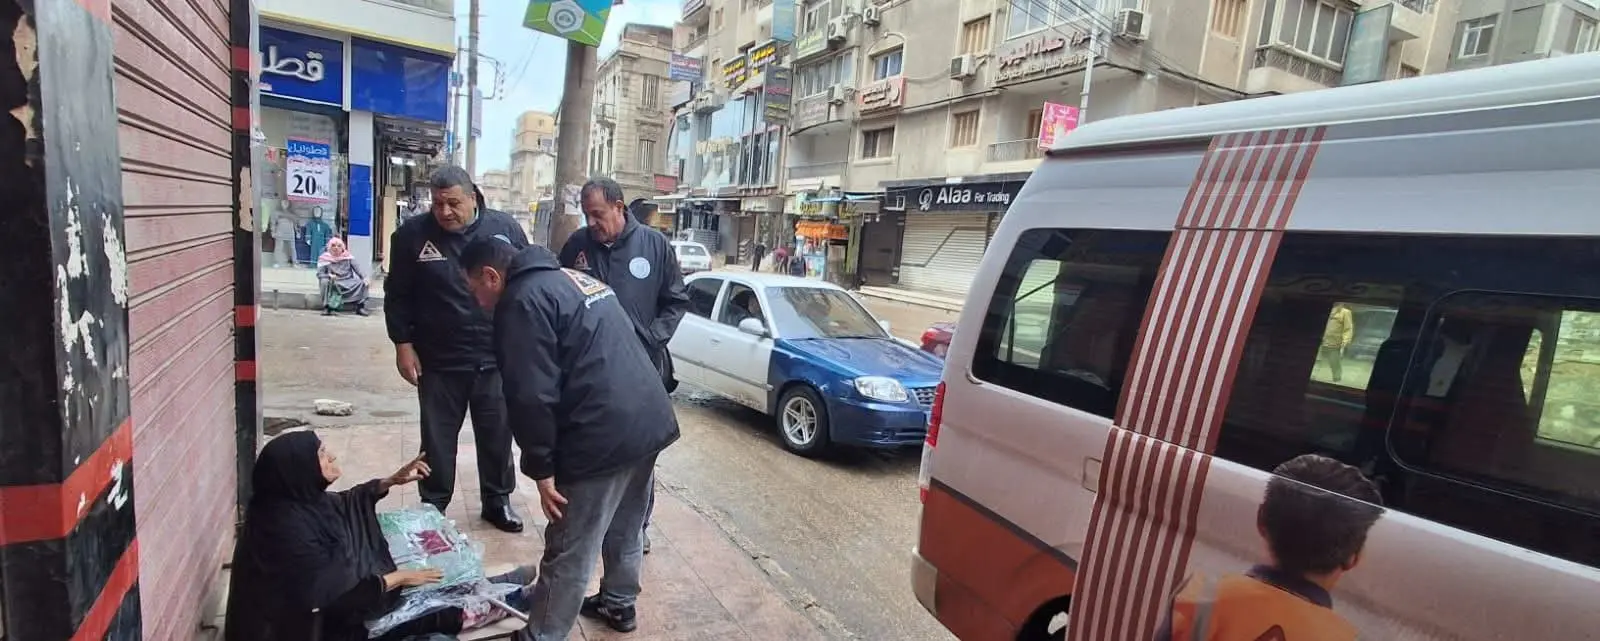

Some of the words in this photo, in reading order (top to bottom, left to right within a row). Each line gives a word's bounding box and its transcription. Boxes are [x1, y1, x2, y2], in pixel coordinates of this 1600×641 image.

[936, 187, 971, 203] Alaa
[974, 192, 985, 202] For
[987, 191, 1010, 204] Trading
